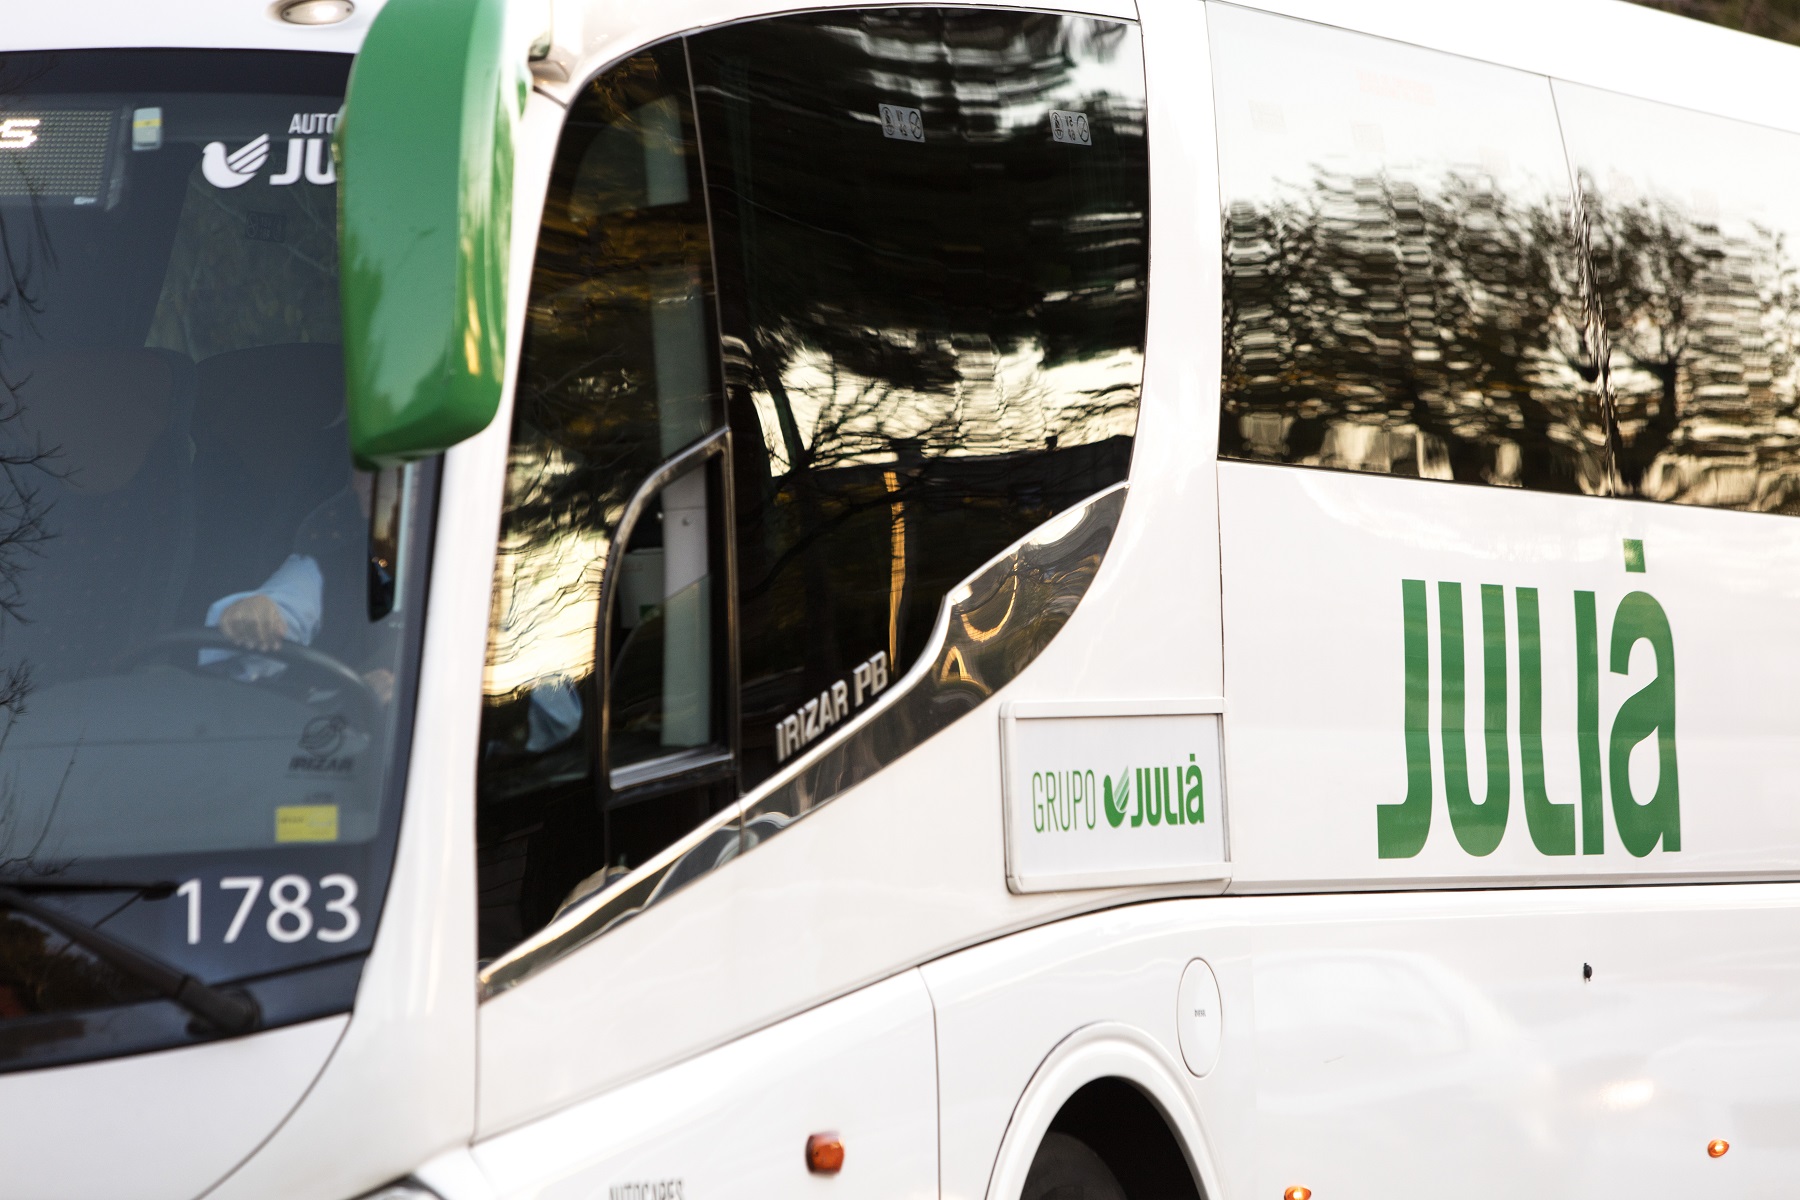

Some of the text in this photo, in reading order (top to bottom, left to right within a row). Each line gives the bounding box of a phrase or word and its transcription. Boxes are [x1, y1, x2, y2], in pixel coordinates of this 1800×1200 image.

[775, 650, 889, 763] IRIZAR PB
[1031, 769, 1097, 833] GRUPO
[176, 873, 360, 944] 1783
